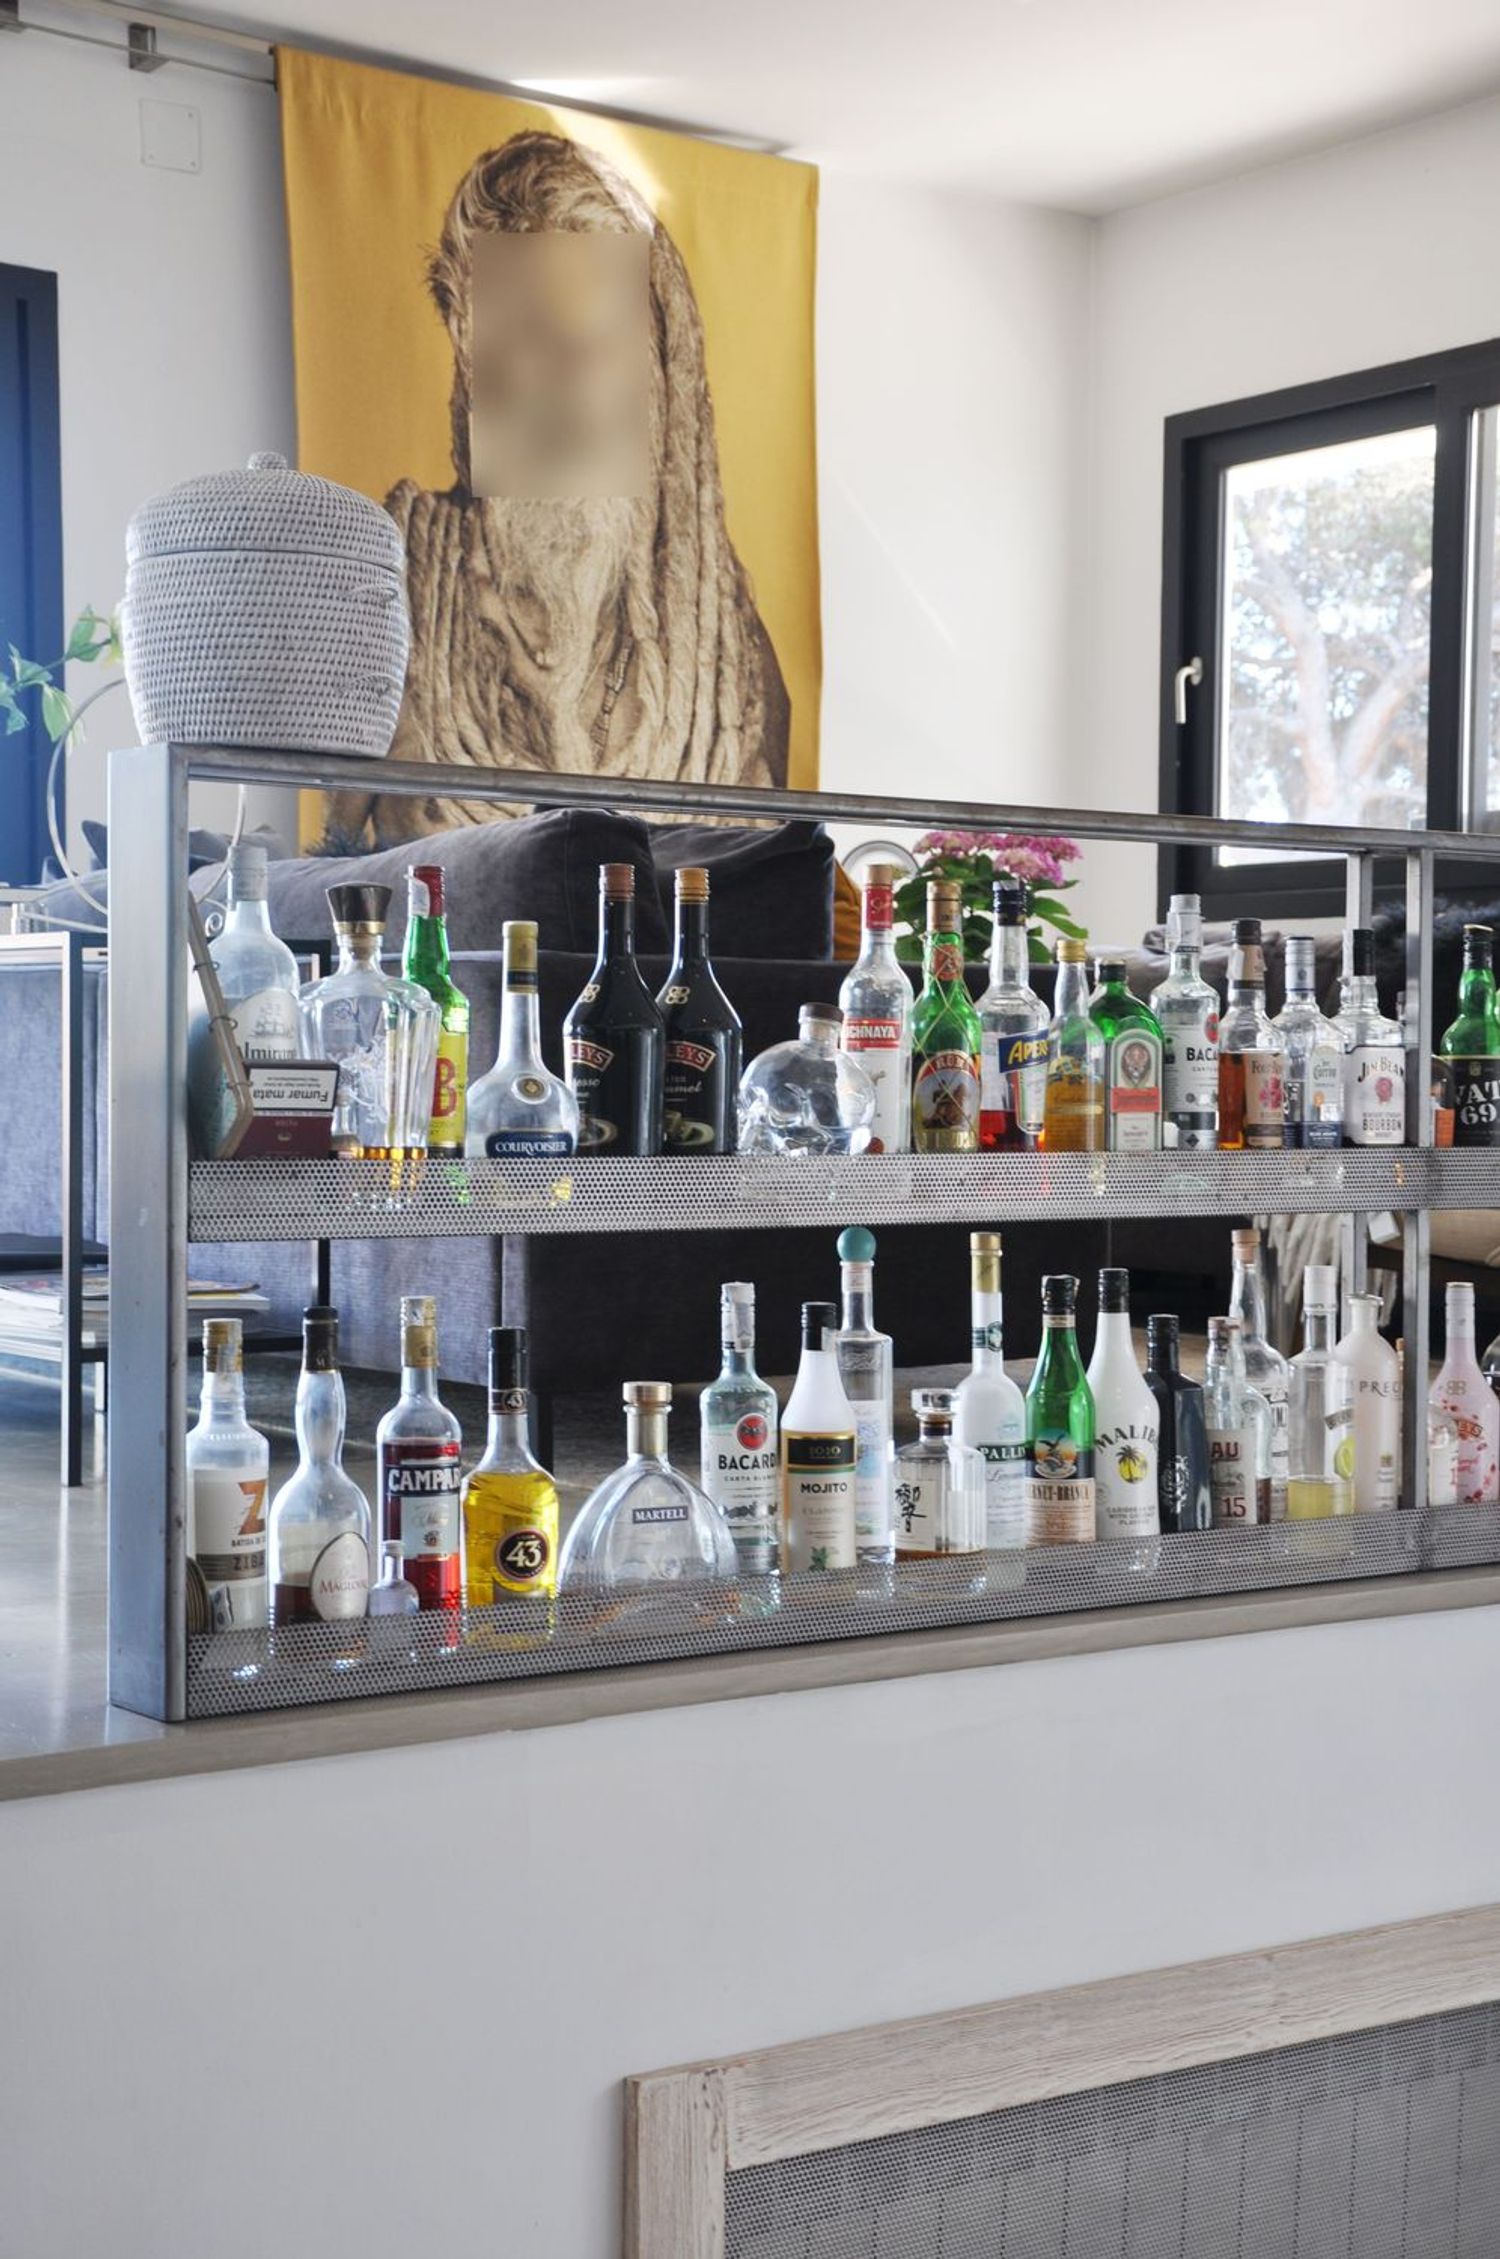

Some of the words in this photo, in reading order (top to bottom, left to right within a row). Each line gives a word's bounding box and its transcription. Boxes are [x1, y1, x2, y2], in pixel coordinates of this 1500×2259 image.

[848, 1025, 896, 1039] CHNAYA
[571, 1042, 605, 1064] LEYS
[666, 1042, 708, 1064] LEYS
[1008, 1039, 1048, 1065] APER
[253, 1087, 285, 1099] mata
[288, 1088, 329, 1102] Fumar
[1461, 1103, 1497, 1125] 69
[495, 1141, 568, 1156] COURVOISIER
[1210, 1441, 1239, 1458] AU
[388, 1467, 460, 1492] CAMPAR
[800, 1482, 848, 1494] MOJITO
[635, 1507, 687, 1521] MARTELL
[1221, 1497, 1247, 1518] 15
[505, 1539, 543, 1568] 43
